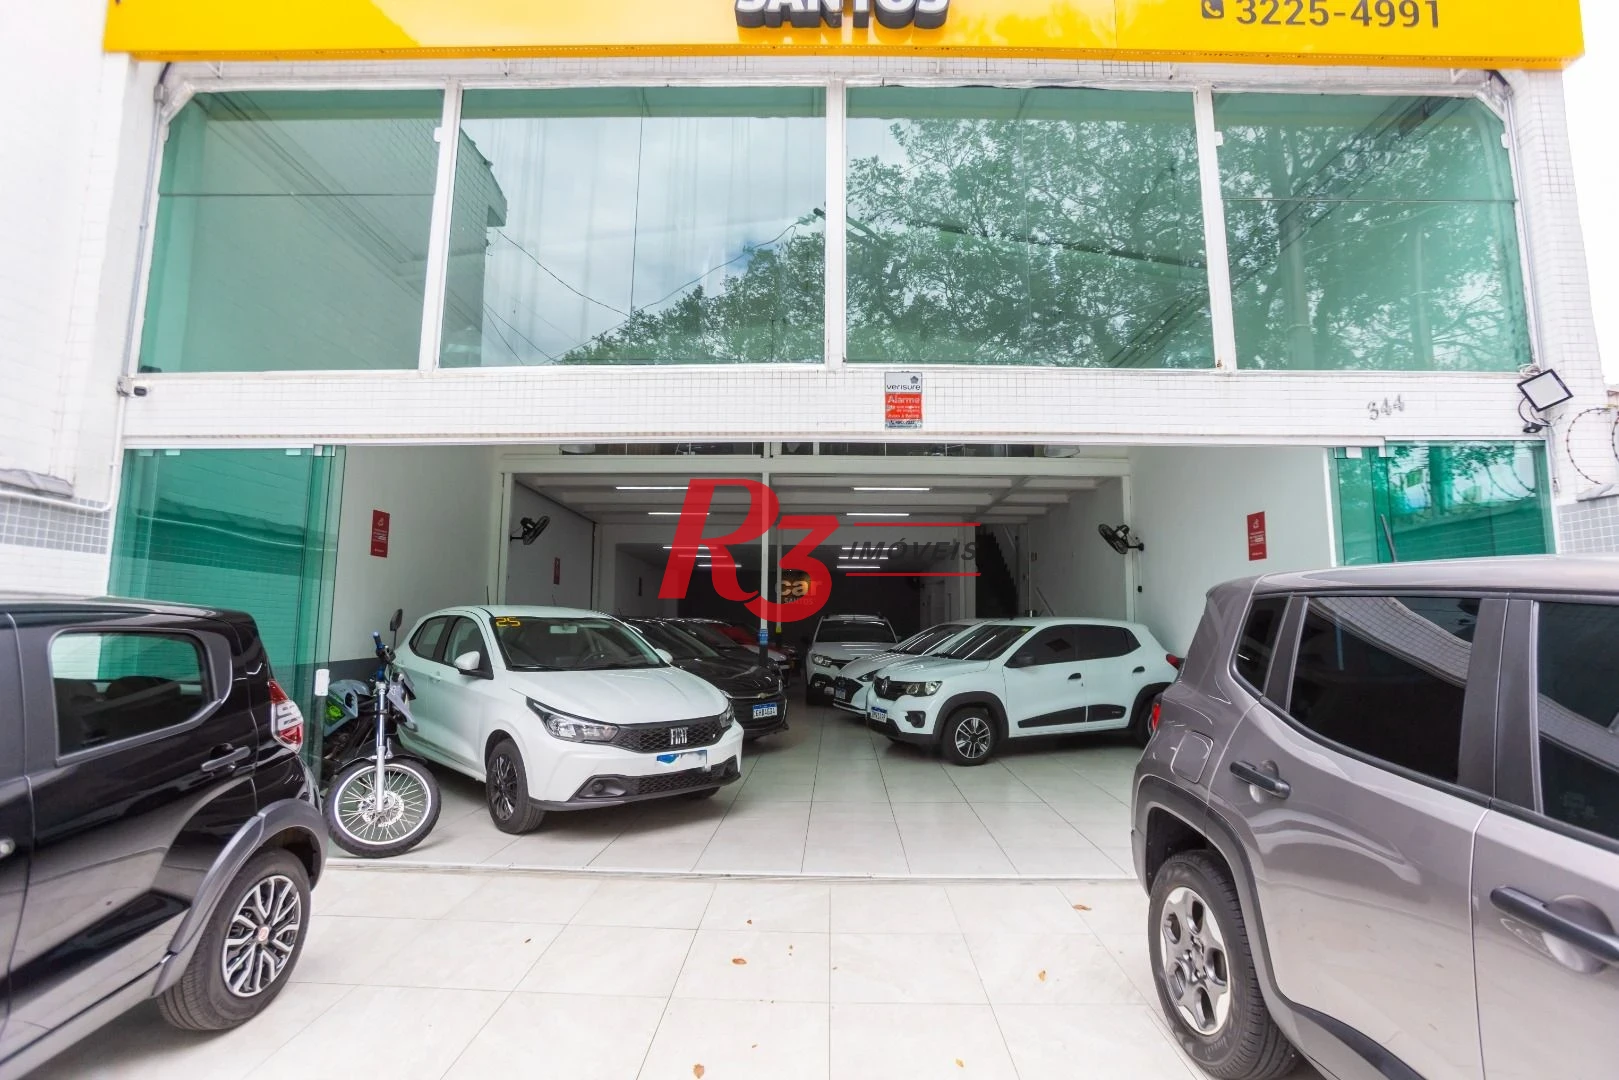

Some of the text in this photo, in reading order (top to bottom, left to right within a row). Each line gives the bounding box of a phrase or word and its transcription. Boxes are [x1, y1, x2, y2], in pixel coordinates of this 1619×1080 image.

[1236, 0, 1439, 28] 3225-4991
[495, 616, 521, 627] 25
[670, 727, 688, 745] FIAT
